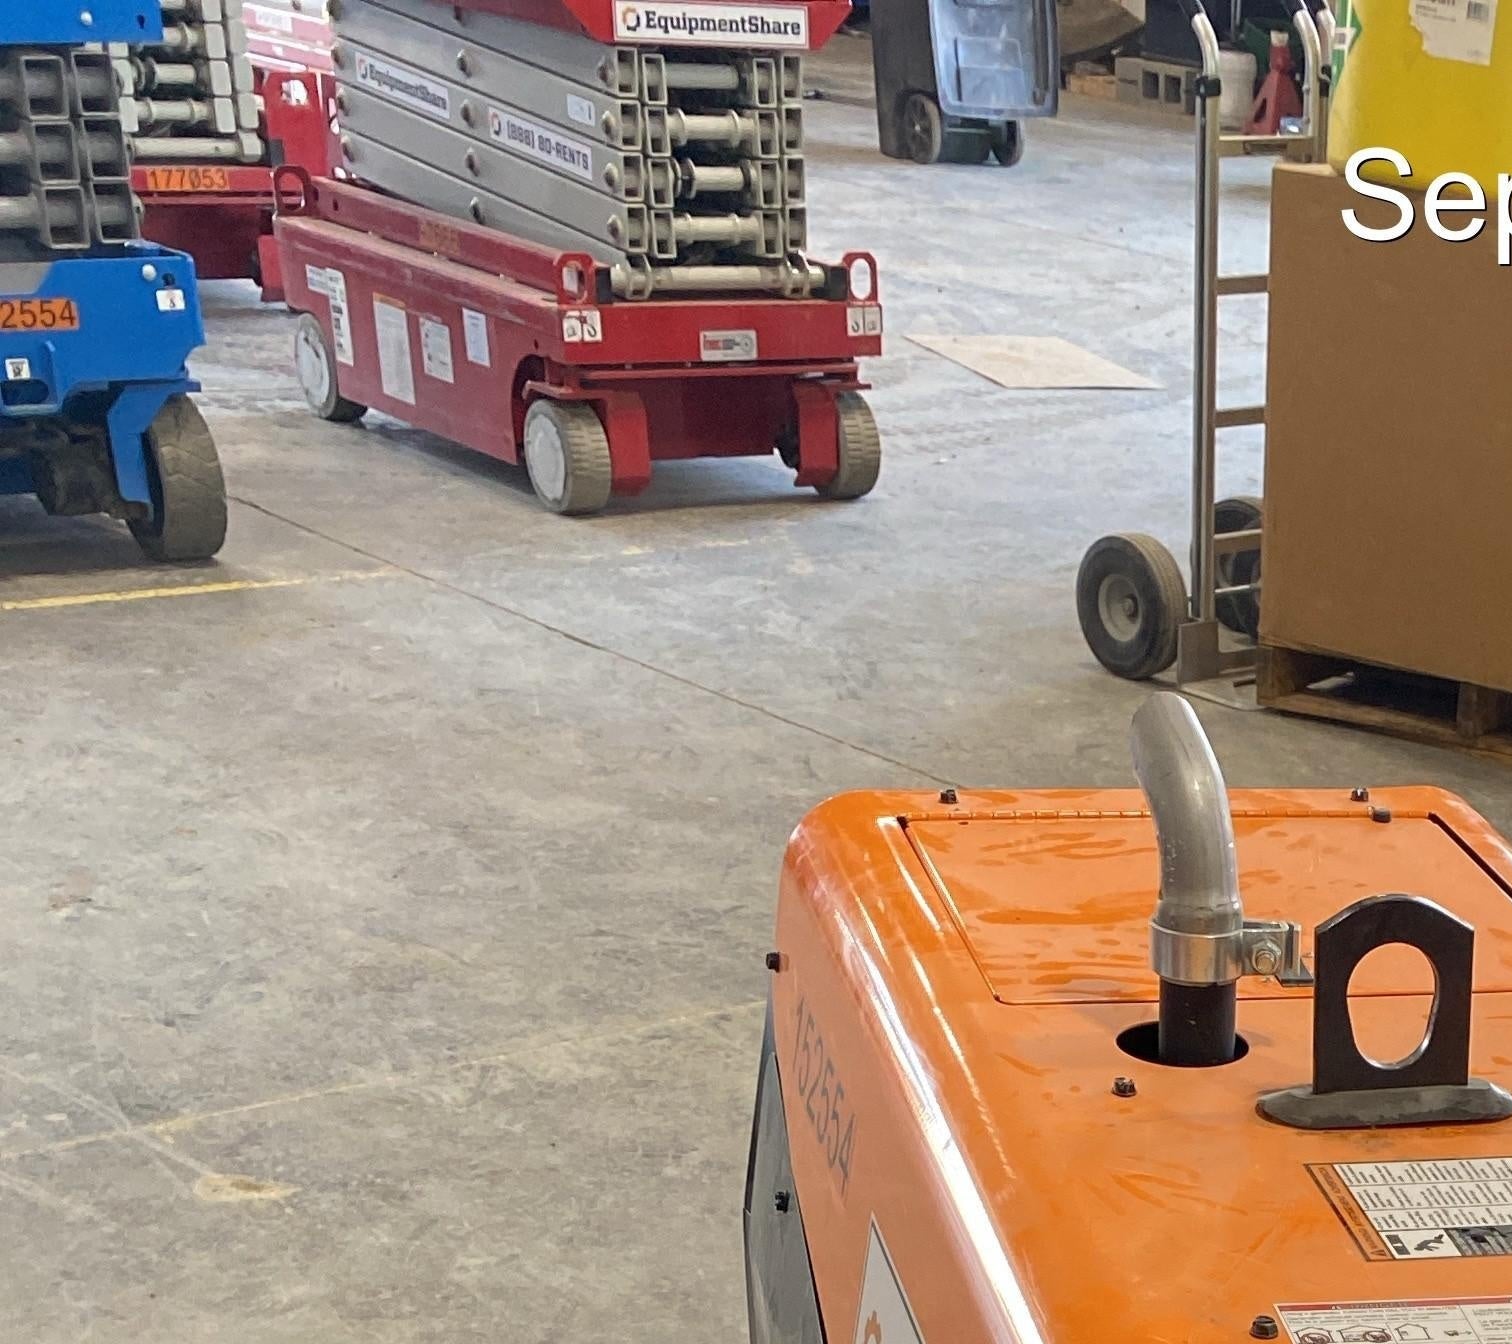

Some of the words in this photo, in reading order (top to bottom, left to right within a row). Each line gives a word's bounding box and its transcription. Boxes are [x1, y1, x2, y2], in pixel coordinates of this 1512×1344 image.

[645, 10, 801, 36] EquipmentShare
[369, 64, 449, 111] EquipmentShare
[150, 168, 228, 189] 177053
[0, 301, 76, 329] 2554
[792, 1002, 856, 1198] 152554
